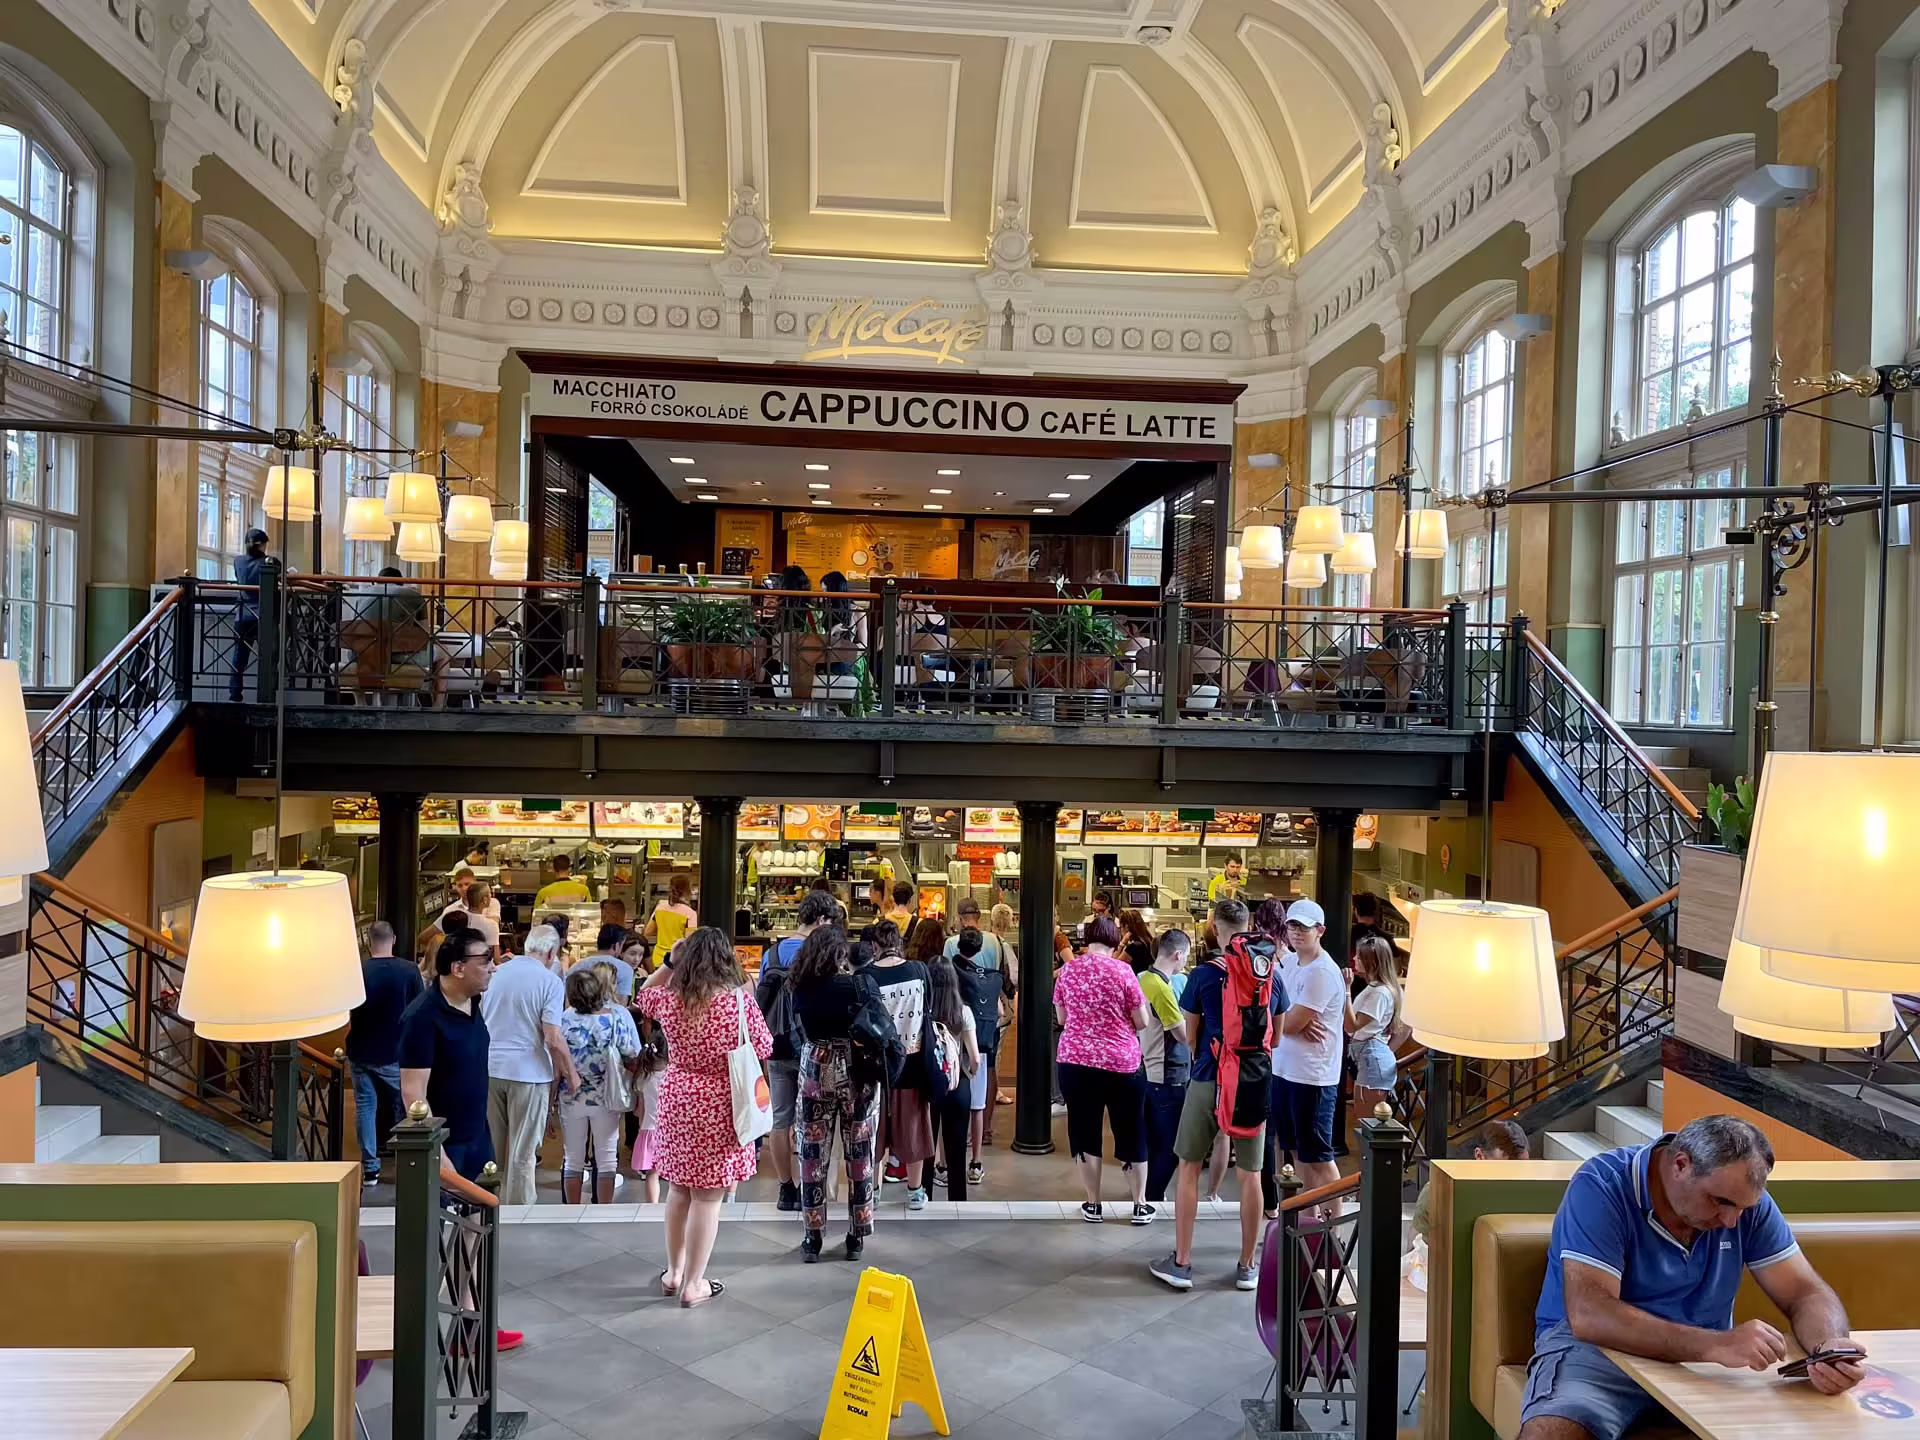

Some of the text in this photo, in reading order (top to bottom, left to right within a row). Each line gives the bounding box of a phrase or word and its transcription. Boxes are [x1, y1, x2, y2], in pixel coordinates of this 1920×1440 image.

[803, 296, 987, 364] McCafé
[553, 379, 676, 400] MACCHIATO
[591, 400, 749, 420] FORRÓ CSOKOLÁDÉ
[760, 390, 1029, 432] CAPPUCCINO
[1040, 408, 1216, 439] CAFÉ LATTE
[881, 987, 920, 1001] ERLIN
